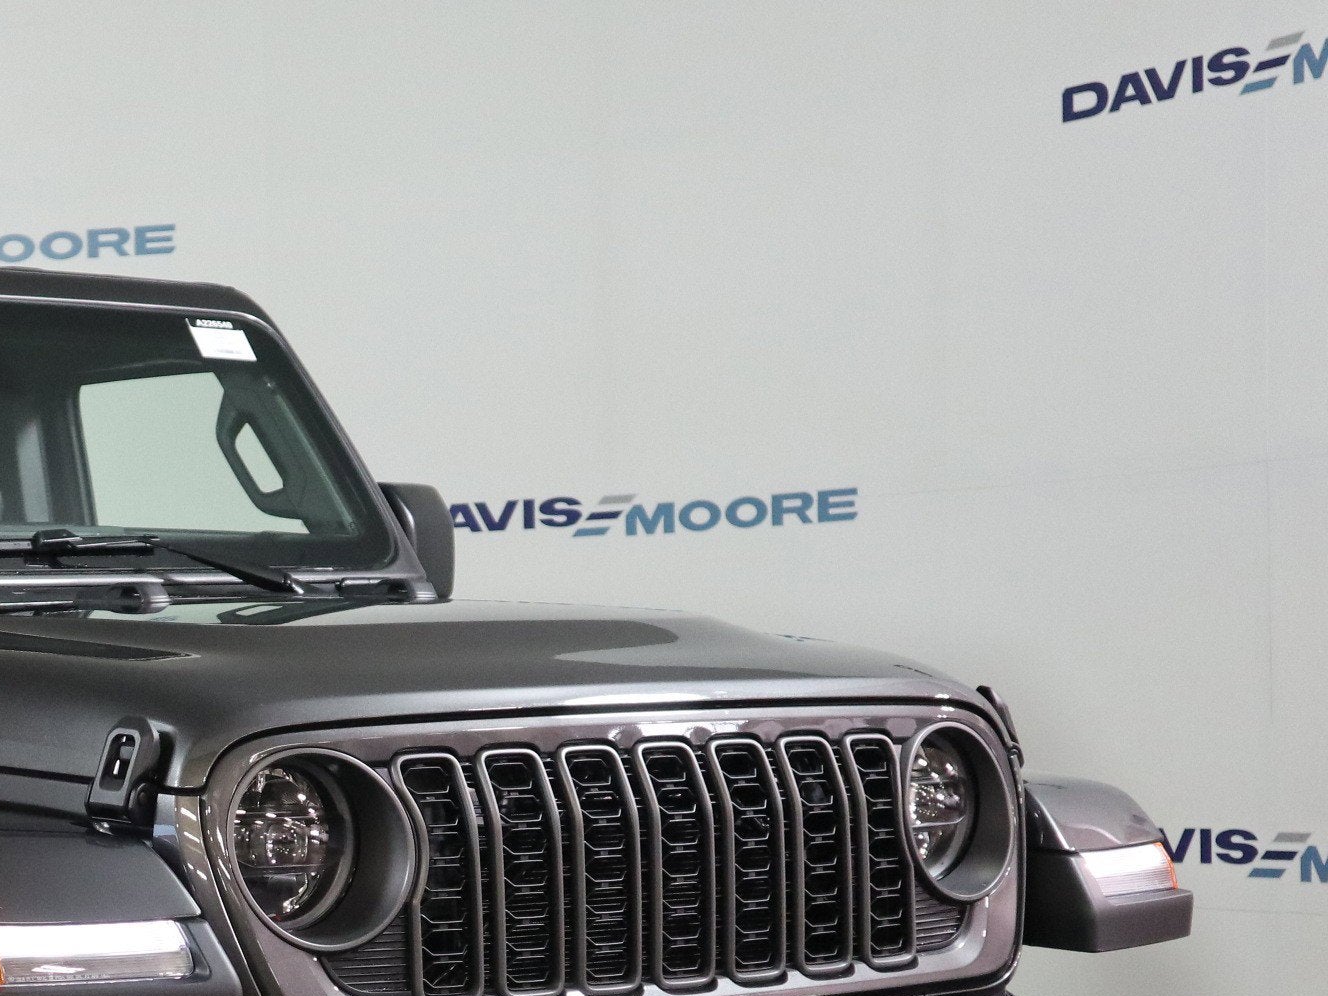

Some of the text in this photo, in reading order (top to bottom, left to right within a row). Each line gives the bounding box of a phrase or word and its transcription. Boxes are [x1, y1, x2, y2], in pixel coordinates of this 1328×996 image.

[1062, 46, 1251, 123] DAVIS
[449, 487, 859, 537] AVIS MOORE
[1158, 827, 1259, 865] VIS
